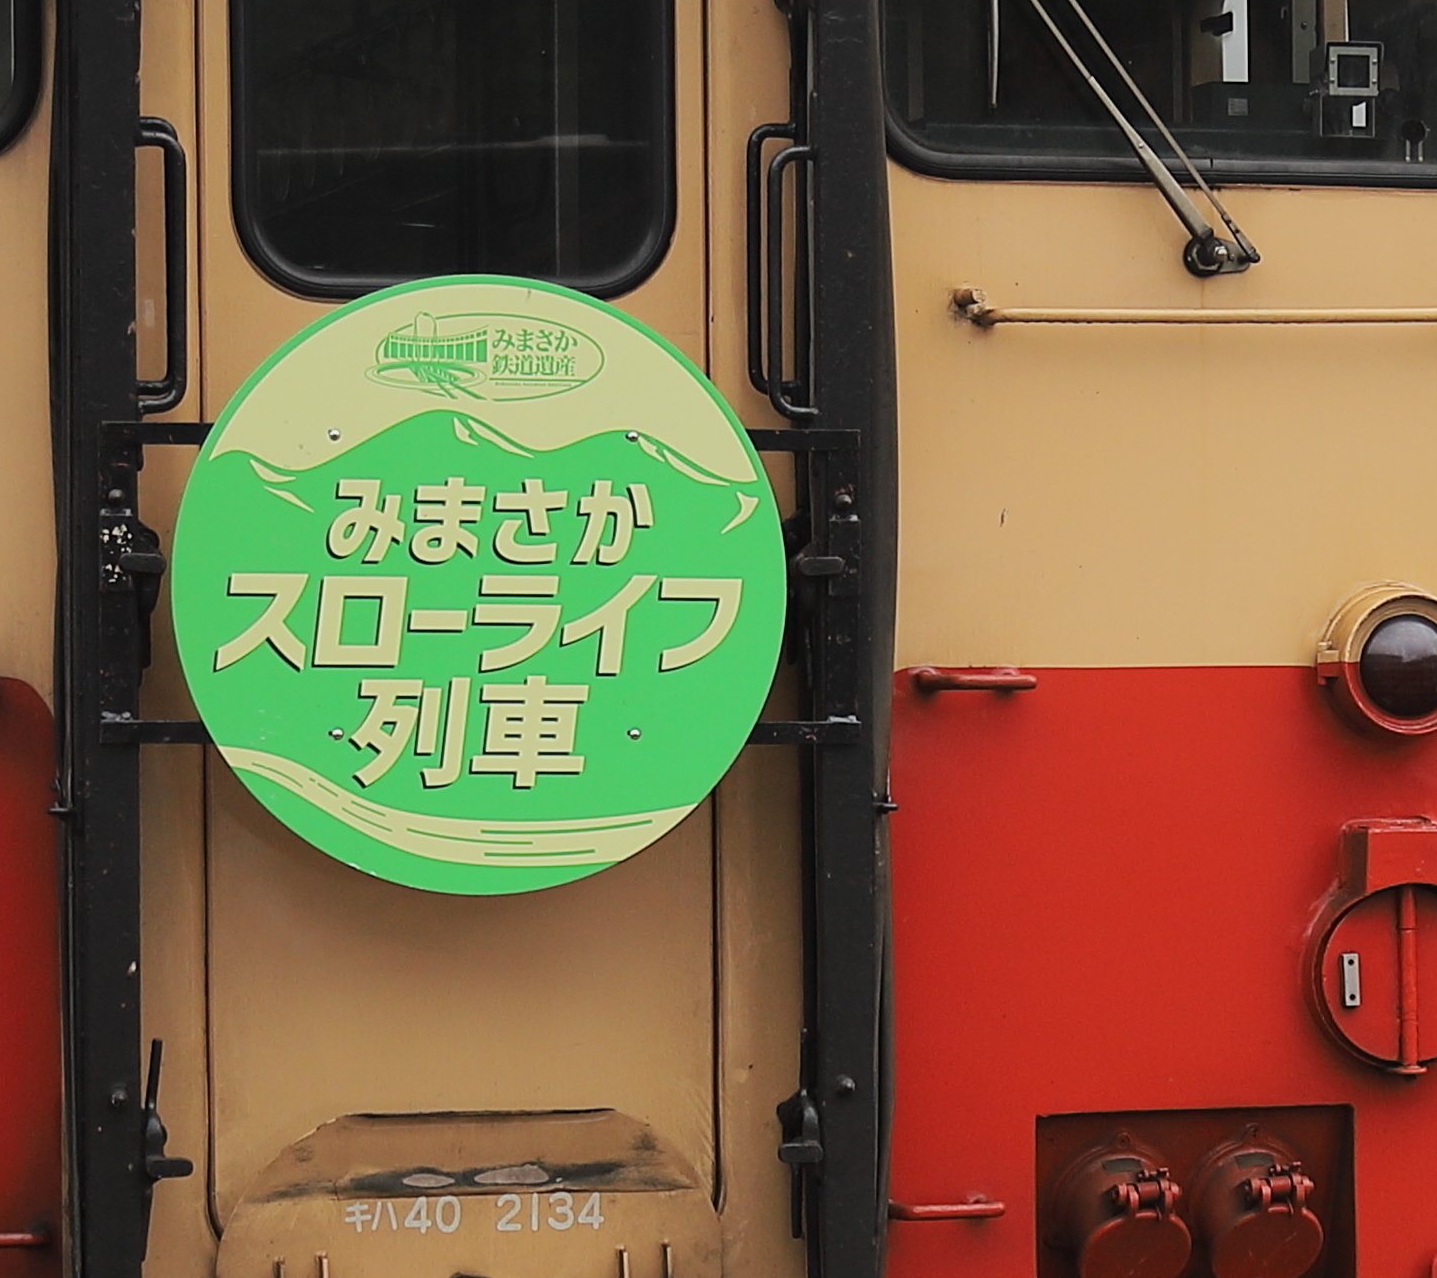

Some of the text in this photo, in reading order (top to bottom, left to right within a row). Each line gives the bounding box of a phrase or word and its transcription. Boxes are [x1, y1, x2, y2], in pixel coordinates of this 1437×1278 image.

[492, 328, 578, 353] みまさか
[492, 354, 576, 377] 鉄道遺産
[325, 476, 654, 565] みまさか
[214, 573, 744, 676] スローライフ
[348, 675, 590, 789] 列車
[344, 1191, 605, 1234] キハ40 2134
